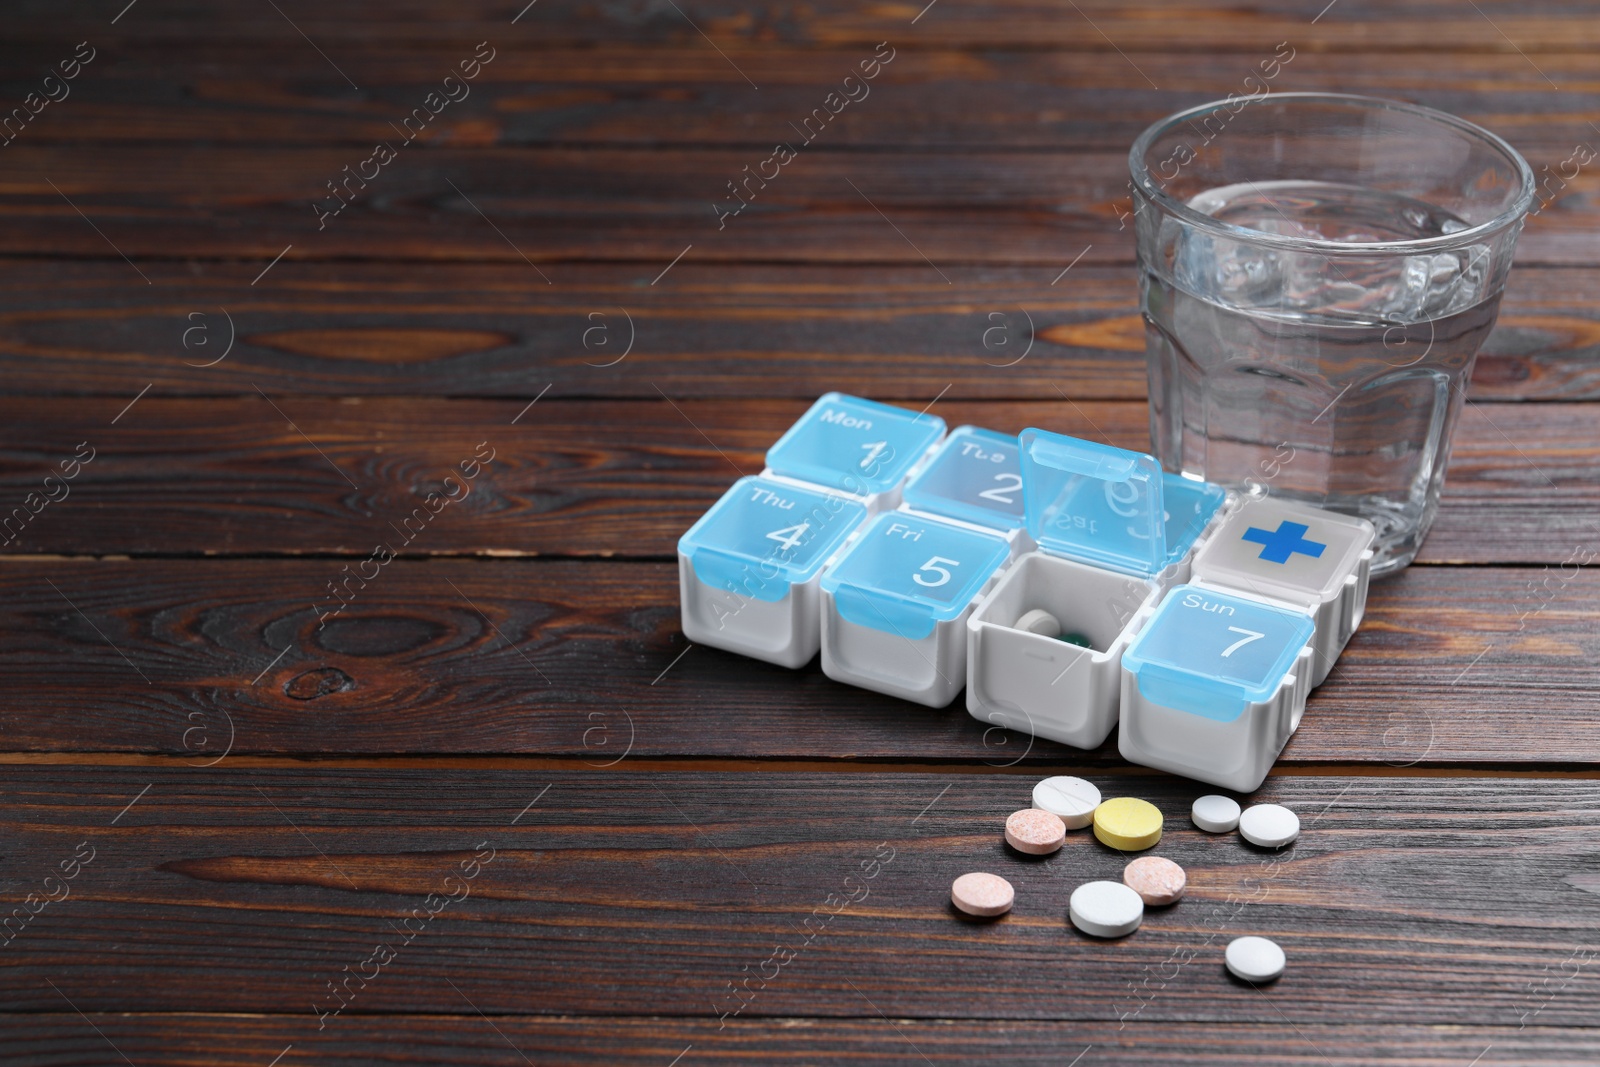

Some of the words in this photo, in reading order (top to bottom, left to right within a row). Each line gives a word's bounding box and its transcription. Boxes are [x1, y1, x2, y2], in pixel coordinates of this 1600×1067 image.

[820, 409, 872, 431] Mon
[861, 440, 888, 468] 1
[751, 487, 796, 510] Thu
[978, 473, 1023, 505] 2
[765, 522, 810, 551] 4
[886, 522, 926, 543] Fri
[912, 555, 961, 588] 5
[1182, 593, 1237, 616] Sun
[1221, 626, 1266, 657] 7
